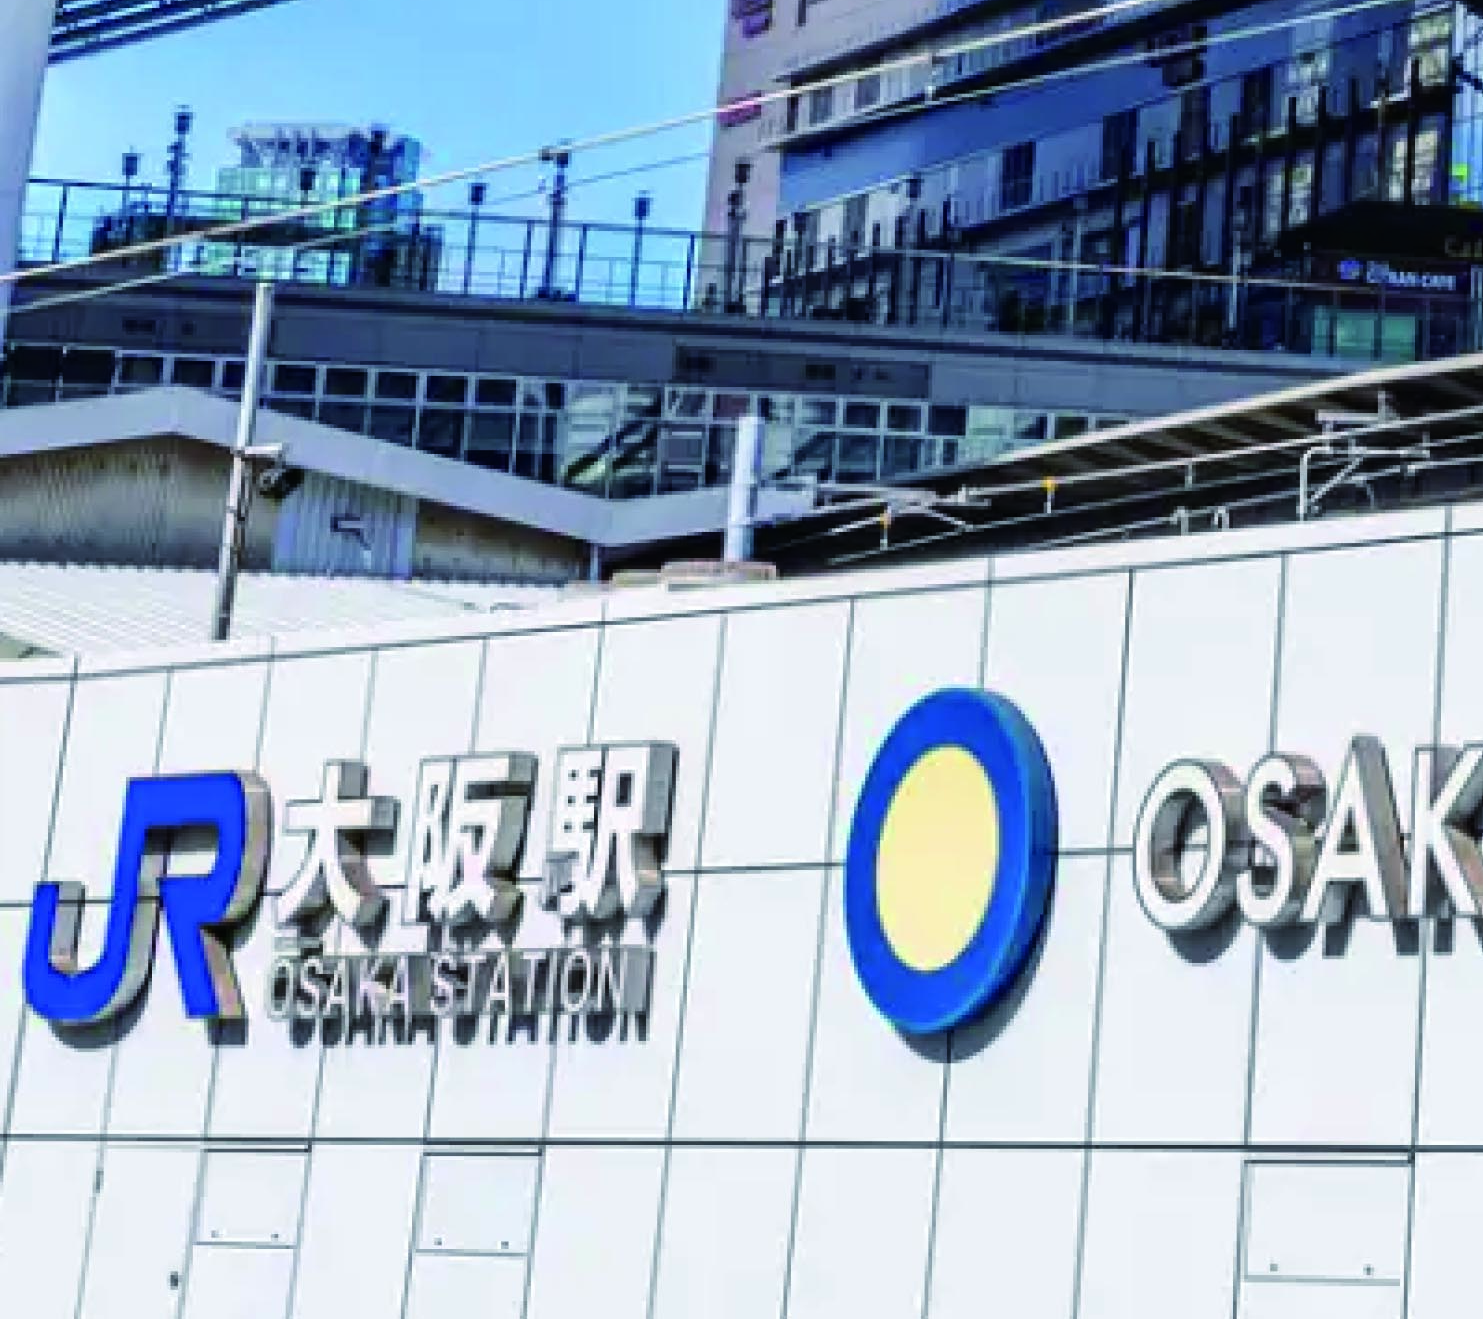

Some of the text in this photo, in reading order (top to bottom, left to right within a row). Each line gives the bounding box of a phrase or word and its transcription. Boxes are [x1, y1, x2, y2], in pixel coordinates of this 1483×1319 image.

[24, 769, 270, 1023] JR
[273, 741, 678, 933] 大阪駅
[266, 949, 654, 1023] OSAKA STATION
